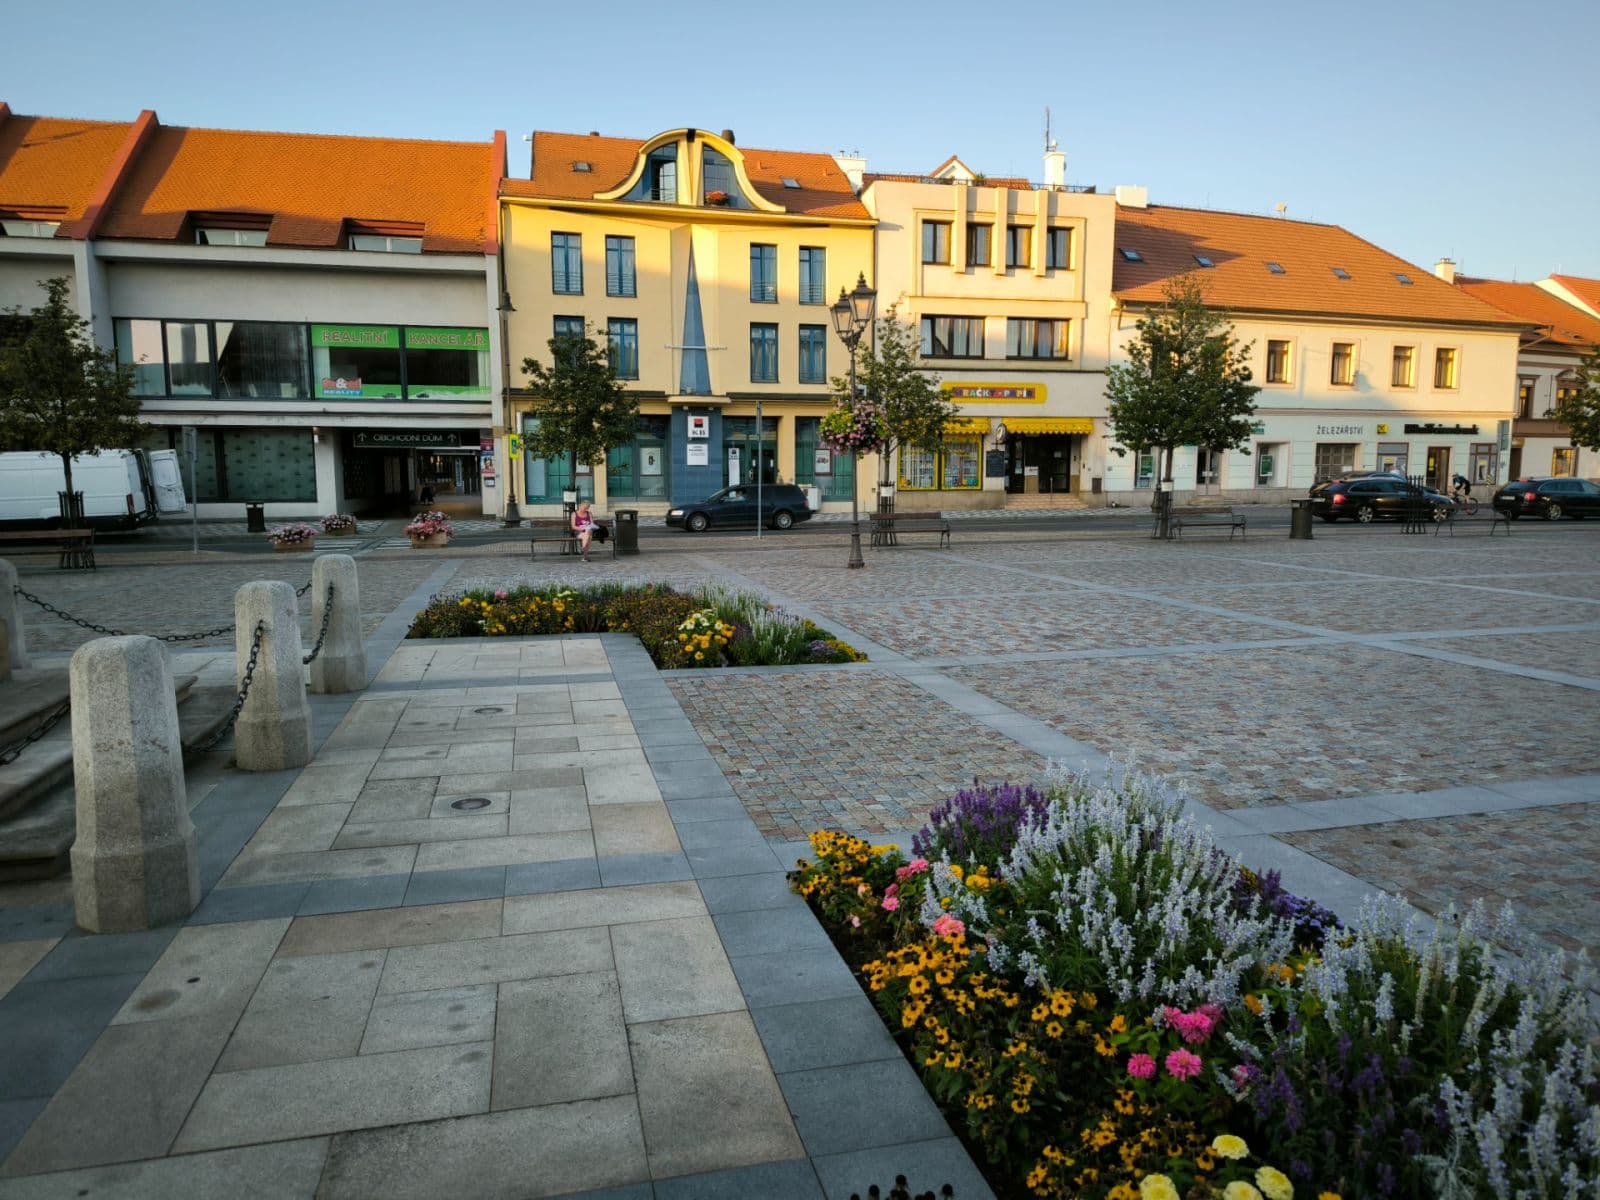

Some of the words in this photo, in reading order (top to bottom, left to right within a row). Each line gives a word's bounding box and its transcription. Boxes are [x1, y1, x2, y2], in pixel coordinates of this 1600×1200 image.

[322, 329, 387, 343] REALITNÍ
[409, 331, 484, 345] KANCELÁŘ
[1316, 425, 1363, 435] ŽELEZÁŘSTVÍ
